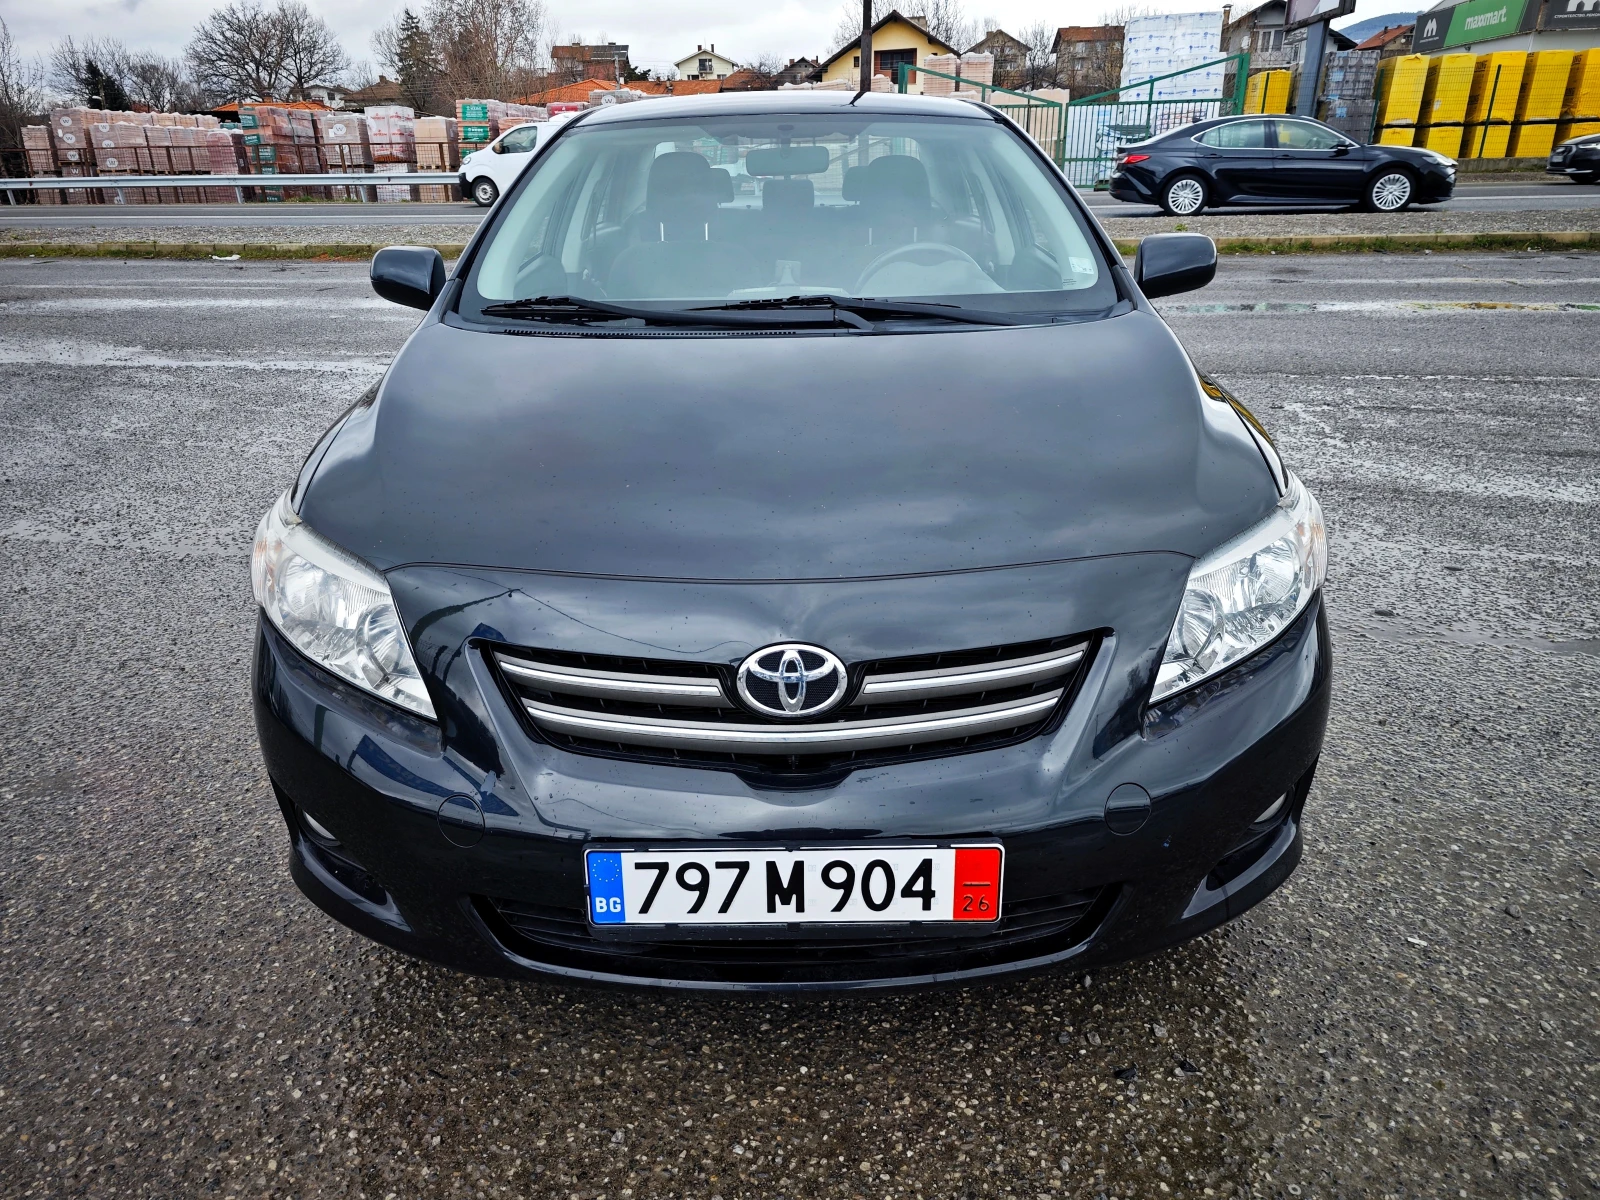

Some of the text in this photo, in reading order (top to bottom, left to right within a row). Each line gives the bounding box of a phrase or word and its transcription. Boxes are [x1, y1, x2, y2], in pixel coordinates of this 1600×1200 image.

[595, 858, 936, 914] BG 797 M 904
[962, 894, 991, 912] 26
